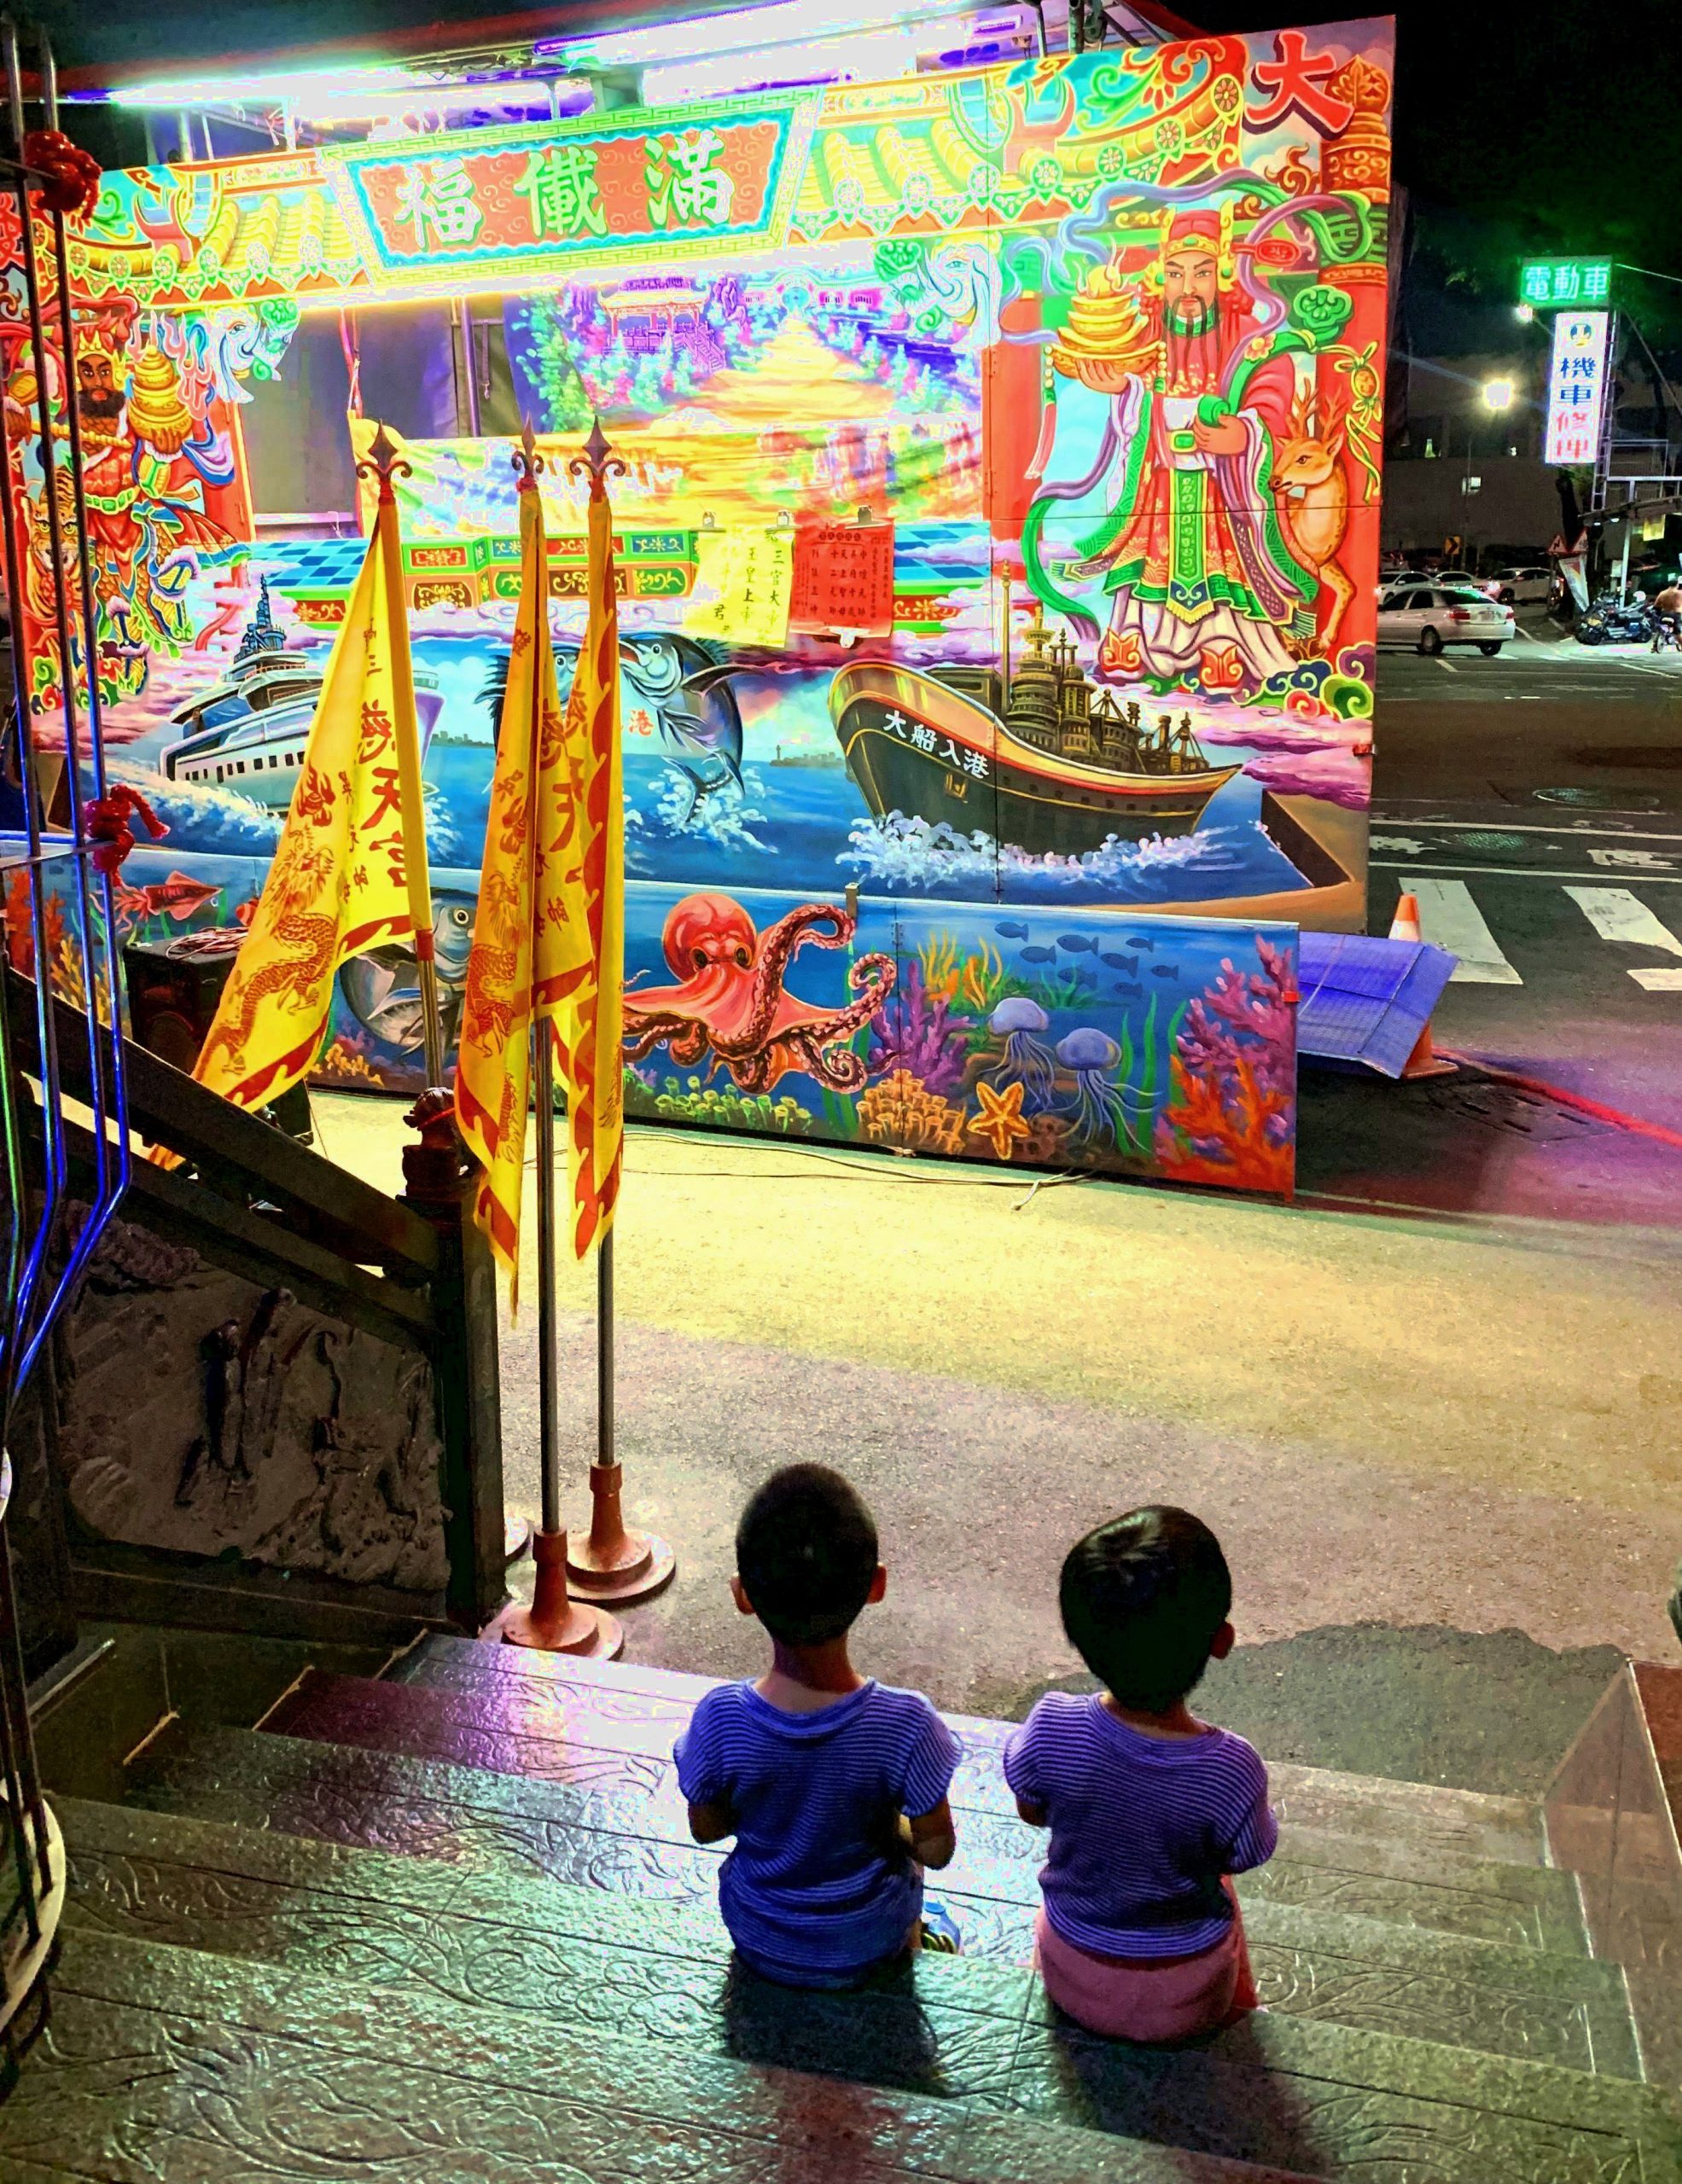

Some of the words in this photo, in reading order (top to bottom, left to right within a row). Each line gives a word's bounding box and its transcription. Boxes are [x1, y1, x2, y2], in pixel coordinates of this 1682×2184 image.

[1244, 30, 1356, 136] 大
[1524, 263, 1610, 300] 電動車
[1557, 357, 1597, 460] 機車修理
[882, 710, 990, 779] 大船入港
